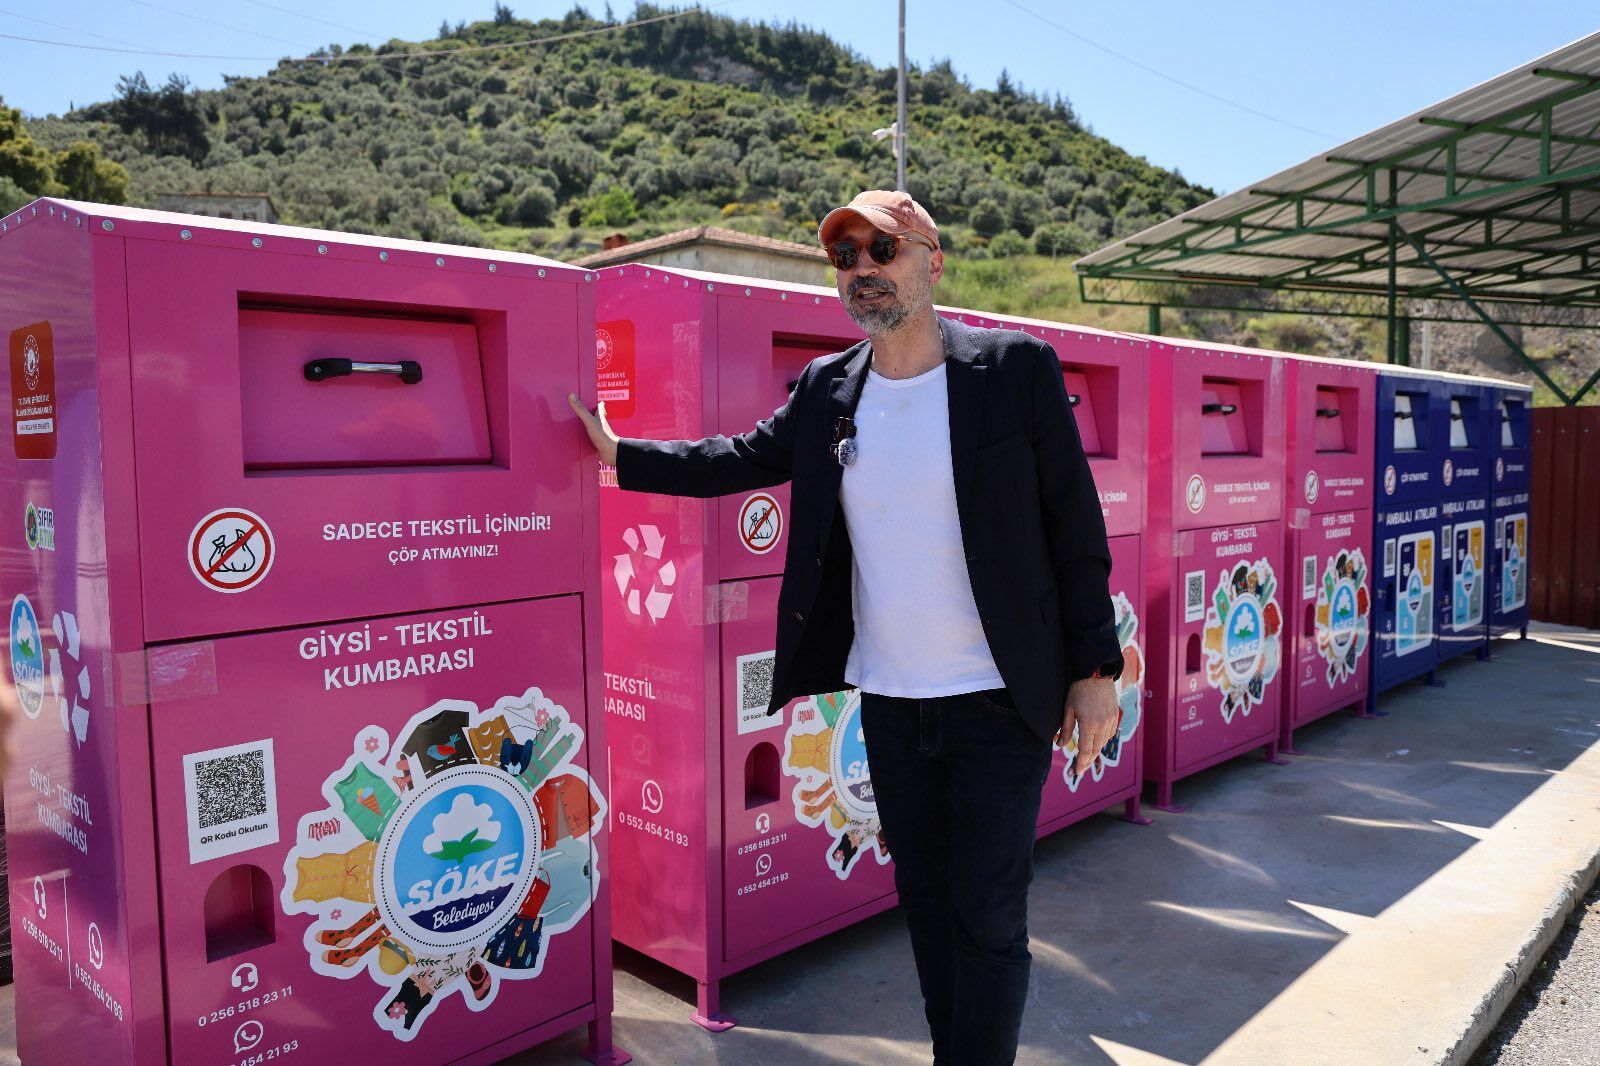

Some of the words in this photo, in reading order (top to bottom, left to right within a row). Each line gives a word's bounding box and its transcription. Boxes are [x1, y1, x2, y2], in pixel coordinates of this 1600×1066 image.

[322, 521, 403, 541] SADECE
[407, 514, 482, 537] TEKSTİL
[485, 511, 551, 536] İÇİNDİR!
[388, 546, 419, 565] ÇÖP
[422, 545, 499, 561] ATMAYINIZ!
[299, 623, 371, 660] GİYSİ
[395, 611, 492, 646] TEKSTİL
[324, 648, 474, 690] KUMBARASI
[603, 672, 656, 700] TEKSTİL
[29, 764, 51, 798] GİYSİ
[57, 784, 92, 826] TEKSTİL
[37, 801, 88, 855] KUMBARASI
[200, 835, 213, 844] QR
[214, 830, 237, 841] Kodu
[238, 823, 269, 835] Okutun
[619, 811, 625, 823] 0
[626, 814, 643, 830] 552
[645, 821, 663, 837] 454
[664, 828, 674, 841] 21
[676, 833, 688, 847] 93
[738, 847, 743, 855] 0
[744, 843, 757, 853] 256
[771, 835, 780, 844] 23
[781, 833, 787, 841] 11
[404, 852, 519, 908] SÖKE
[737, 888, 743, 896] 0
[744, 883, 757, 893] 552
[758, 878, 771, 889] 454
[771, 875, 779, 884] 21
[780, 872, 789, 881] 93
[432, 896, 496, 930] Belediyesi
[22, 916, 27, 931] 0
[57, 945, 63, 962] 11
[75, 962, 80, 978] 0
[92, 980, 105, 1004] 454
[105, 992, 113, 1012] 21
[198, 1016, 207, 1027] 0
[210, 1006, 235, 1023] 256
[238, 997, 260, 1013] 518
[263, 991, 279, 1005] 23
[281, 985, 293, 997] 11
[266, 1046, 280, 1060] 21
[282, 1040, 299, 1053] 93
